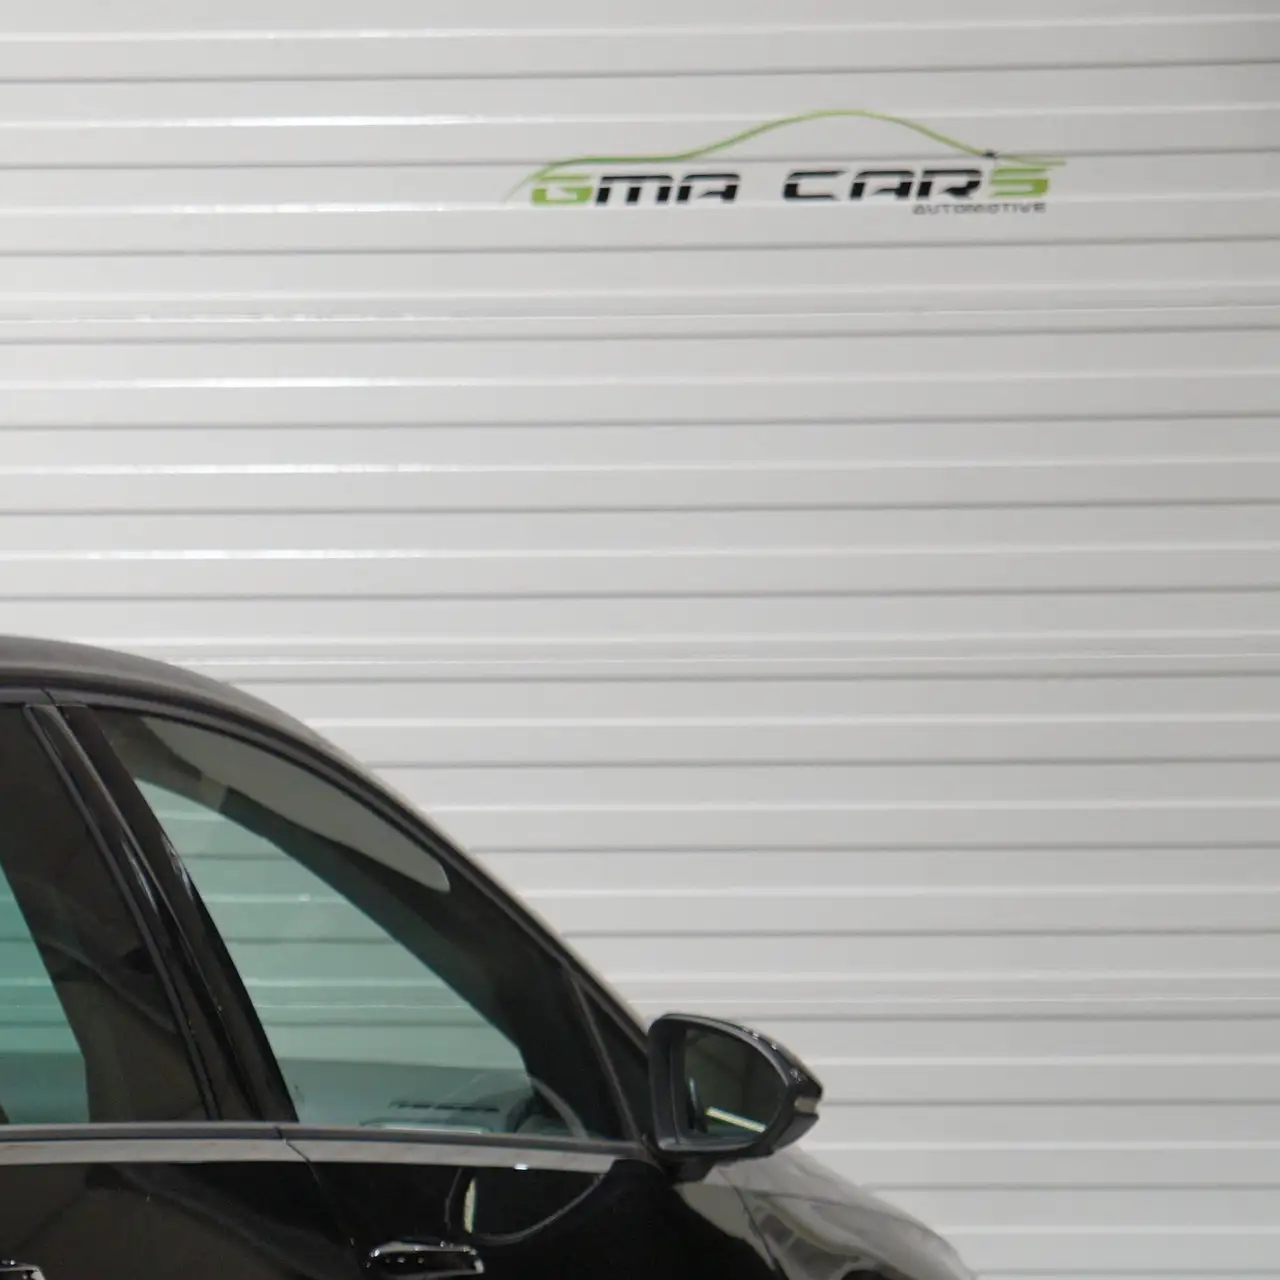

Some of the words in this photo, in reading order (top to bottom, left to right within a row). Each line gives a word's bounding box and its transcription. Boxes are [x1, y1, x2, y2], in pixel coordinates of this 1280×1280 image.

[532, 172, 740, 205] GMA
[782, 167, 1051, 201] CARS
[912, 203, 1047, 216] AUTOMOTIVE
